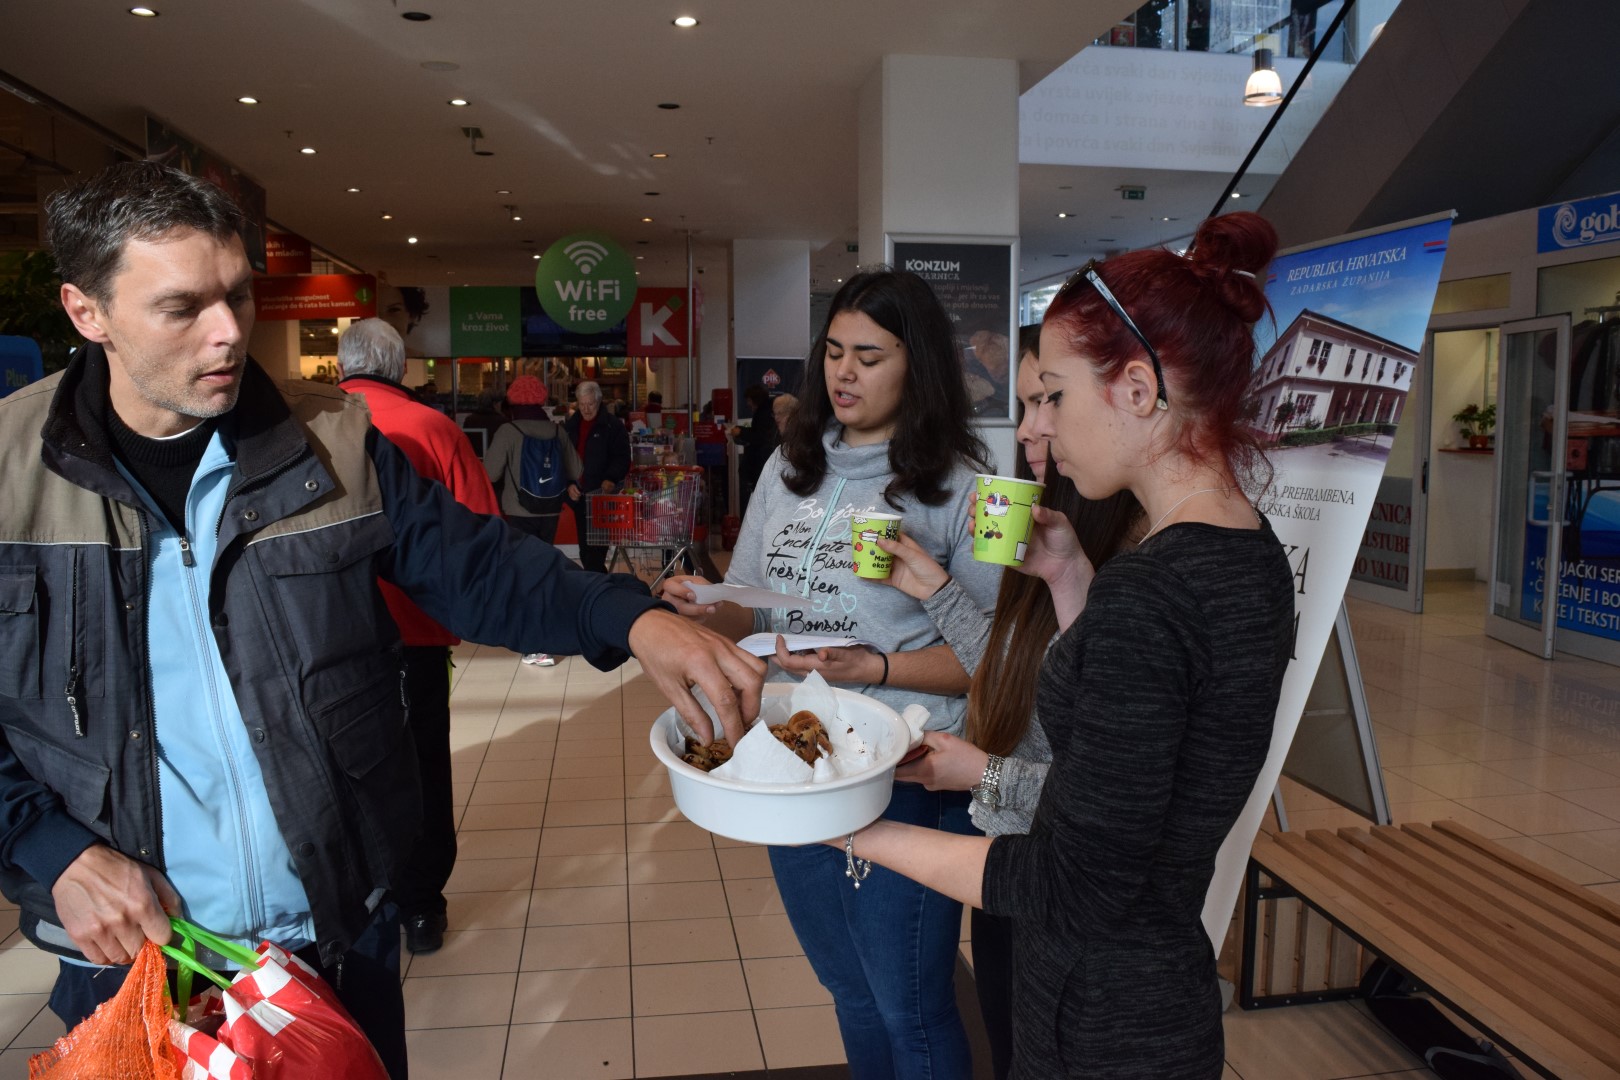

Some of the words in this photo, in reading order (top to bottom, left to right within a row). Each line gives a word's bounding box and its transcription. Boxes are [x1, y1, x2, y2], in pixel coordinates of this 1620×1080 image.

[905, 259, 960, 272] KONZUM
[1286, 260, 1344, 282] REPUBLIKA
[1346, 246, 1407, 271] HRVATSKA
[1290, 280, 1338, 296] ZADARSKA
[1341, 270, 1390, 287] ŽUPANIJA
[475, 312, 504, 321] Vama
[568, 305, 607, 321] free
[462, 322, 484, 332] kroz
[485, 322, 510, 332] život
[762, 373, 780, 385] pik
[1280, 485, 1355, 505] PREHRAMBENA
[1292, 503, 1321, 521] ŠKOLA
[1536, 557, 1597, 580] KJAČKI
[1534, 576, 1591, 604] ČENJE
[786, 609, 858, 634] Bonsoir
